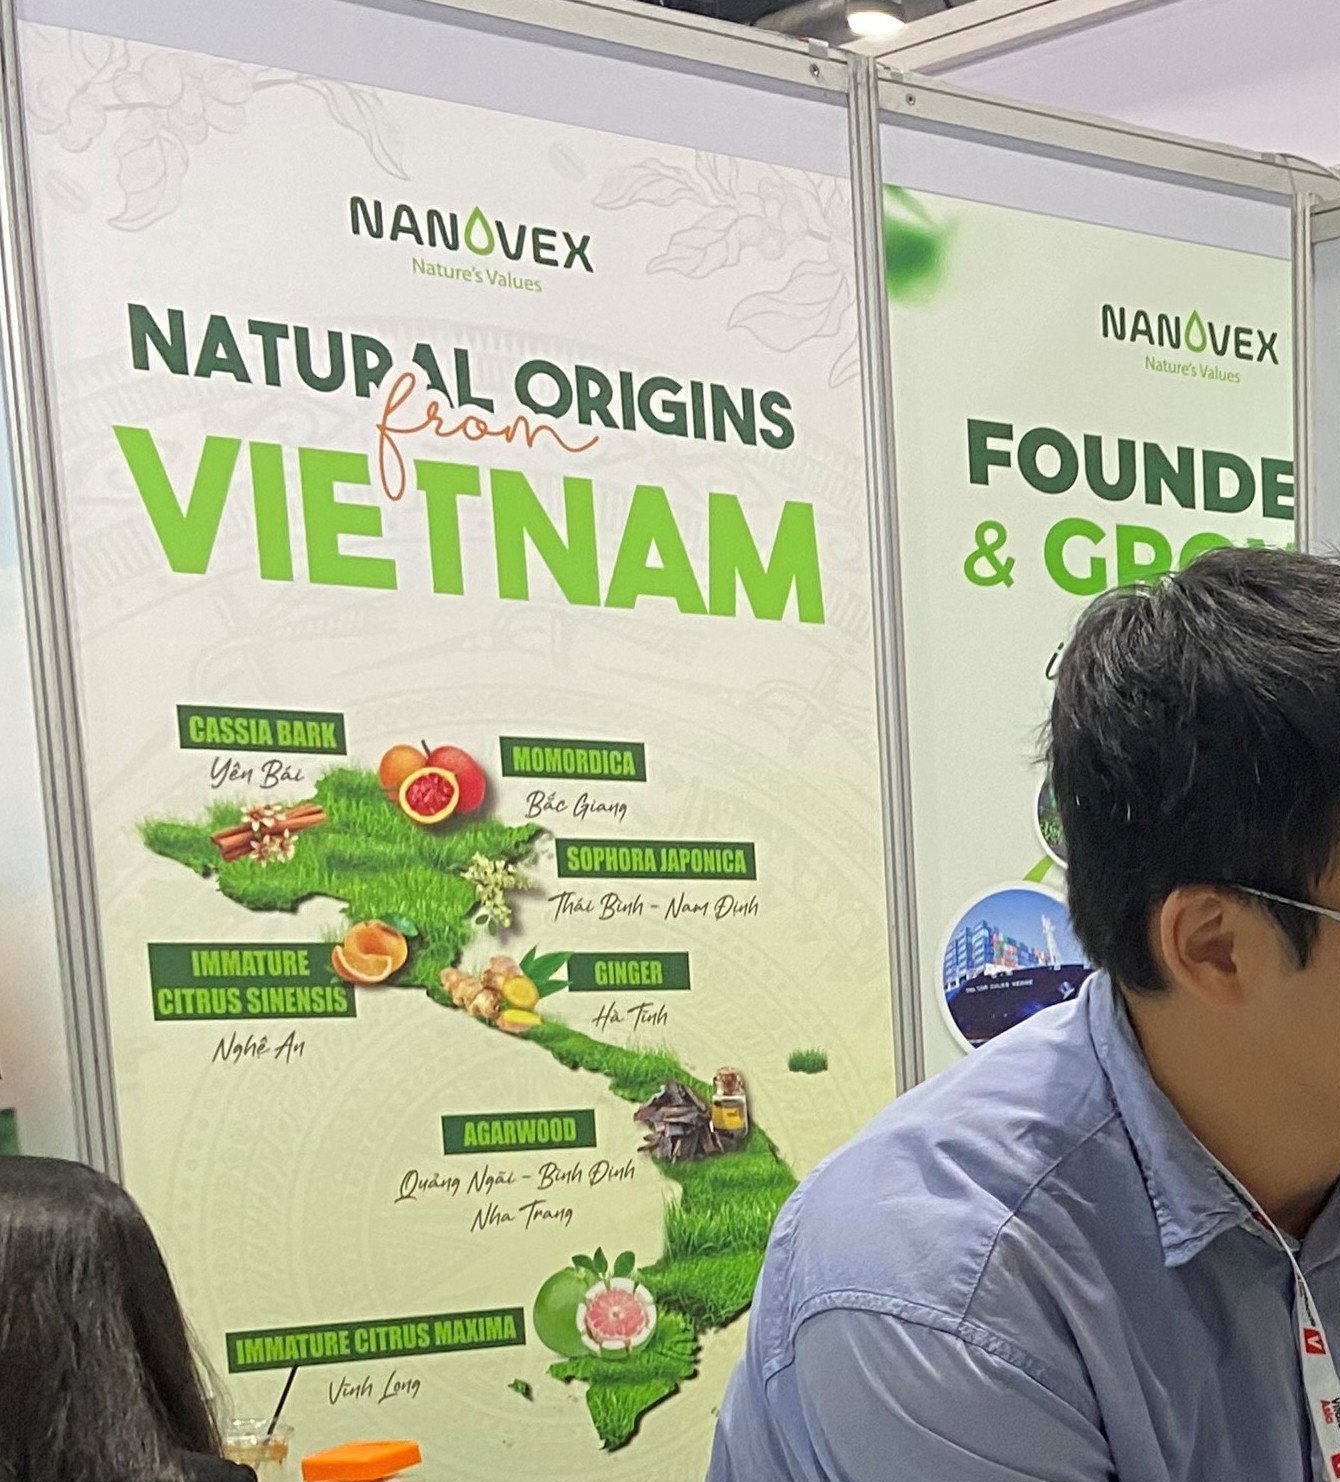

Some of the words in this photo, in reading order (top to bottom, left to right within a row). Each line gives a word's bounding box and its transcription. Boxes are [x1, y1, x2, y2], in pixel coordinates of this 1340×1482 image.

[349, 195, 596, 274] NANOVEX
[411, 256, 483, 287] Nature's
[486, 267, 543, 293] Values
[1101, 303, 1280, 366] NANOVEX
[127, 302, 494, 415] NATURAL
[513, 358, 797, 451] ORIGINS
[1144, 355, 1198, 378] Nature's
[1199, 363, 1241, 384] Values
[375, 371, 600, 502] from
[112, 424, 826, 626] VIETNAM
[963, 520, 1016, 588] &
[189, 715, 273, 746] CASSIA
[276, 719, 337, 748] BARK
[512, 746, 636, 776] MOMORDICA
[567, 846, 656, 871] SOPHORA
[659, 848, 747, 873] JAPONICA
[191, 949, 311, 977] IMMATURE
[594, 960, 663, 985] GINGER
[157, 987, 243, 1015] CITRUS
[246, 986, 348, 1013] SINENSIS
[464, 1117, 577, 1147] AGARWOOD
[235, 1331, 350, 1365] IMMATURE
[354, 1322, 431, 1354] CITRUS
[434, 1315, 517, 1346] MAXIMA
